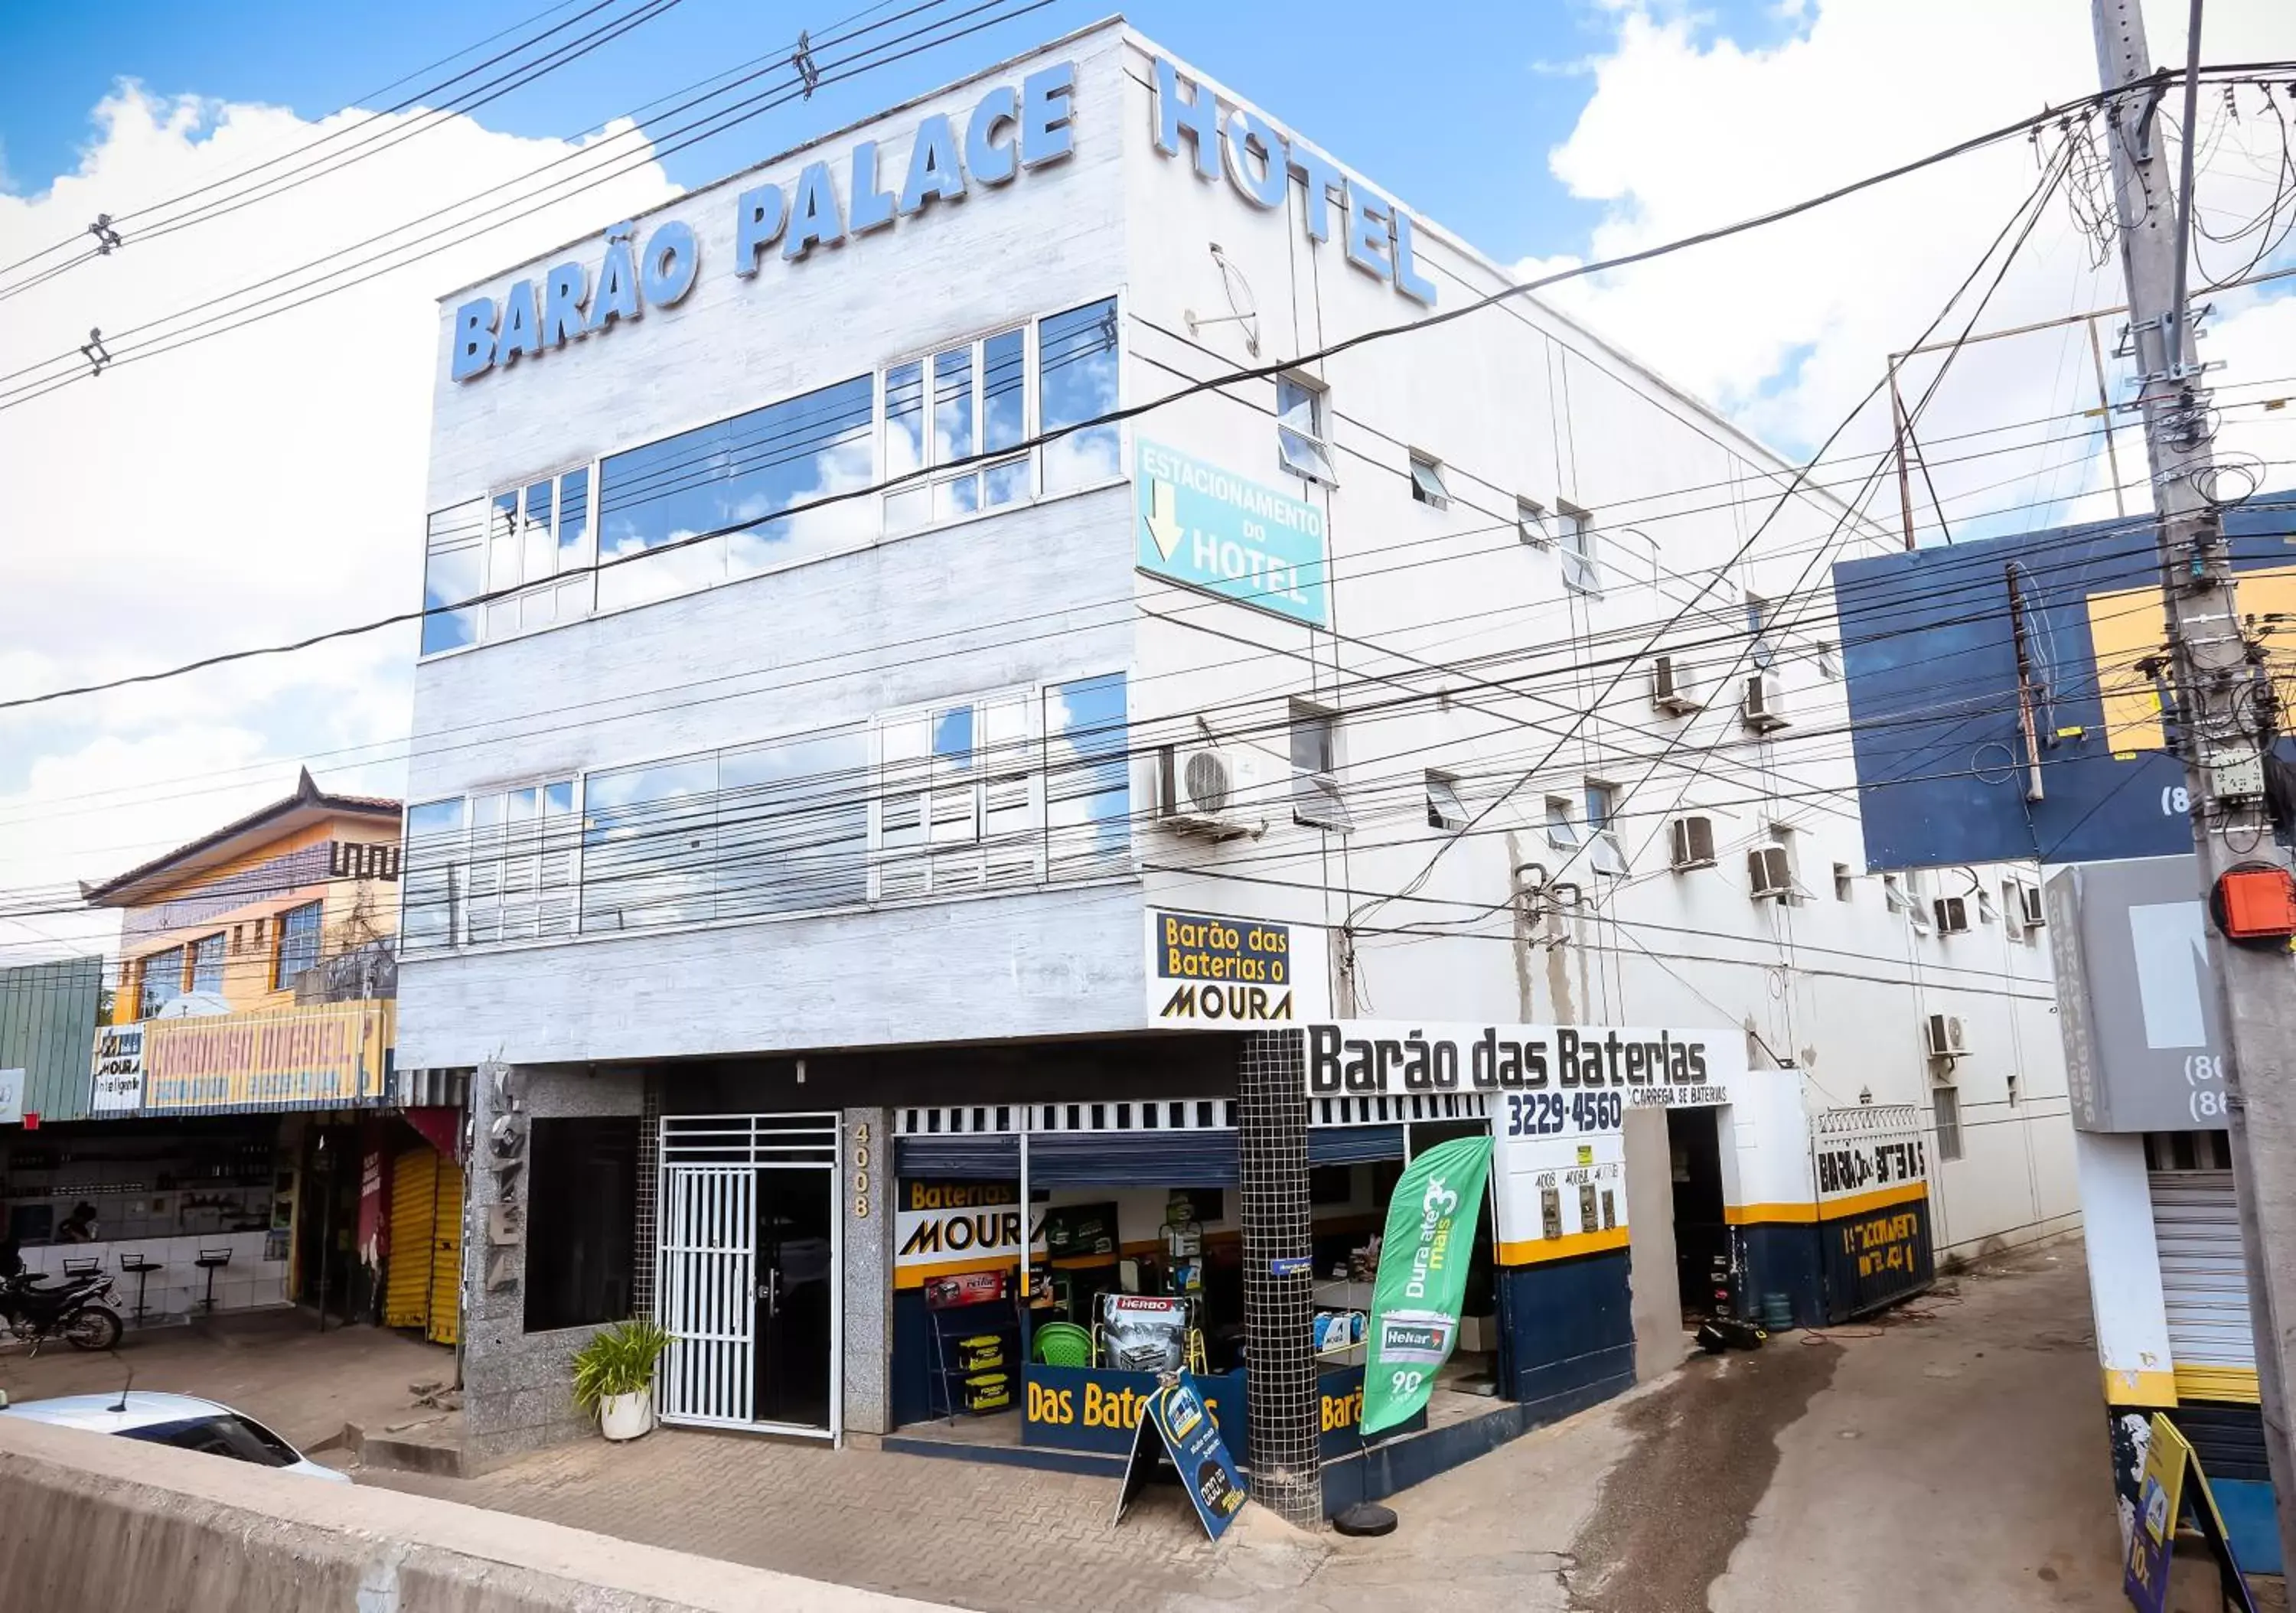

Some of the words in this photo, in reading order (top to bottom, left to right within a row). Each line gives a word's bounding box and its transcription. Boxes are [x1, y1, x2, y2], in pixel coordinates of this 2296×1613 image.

[451, 220, 700, 383] BARÃO
[735, 60, 1077, 279] PALACE
[1153, 54, 1437, 309] HOTEL
[1143, 446, 1322, 537] ESTACIONAMENTO
[1243, 520, 1266, 543] DO
[1192, 529, 1308, 604] HOTEL
[1165, 917, 1240, 950] Barão
[1248, 927, 1287, 953] das
[1168, 948, 1265, 981] Baterias
[1159, 984, 1293, 1020] MOURA
[1307, 1025, 1460, 1095] Barão
[1473, 1027, 1549, 1091] das
[1556, 1028, 1709, 1087] Baterias
[1507, 1091, 1622, 1137] 3229-4560
[856, 1123, 870, 1218] 4008
[912, 1181, 1012, 1210] Baterias
[1405, 1247, 1431, 1299] Dura
[1419, 1210, 1440, 1241] até
[1430, 1217, 1450, 1270] mais
[1392, 1370, 1421, 1393] 90
[1027, 1381, 1074, 1425] Das
[1083, 1382, 1220, 1431] Bates
[1322, 1386, 1363, 1432] Barã
